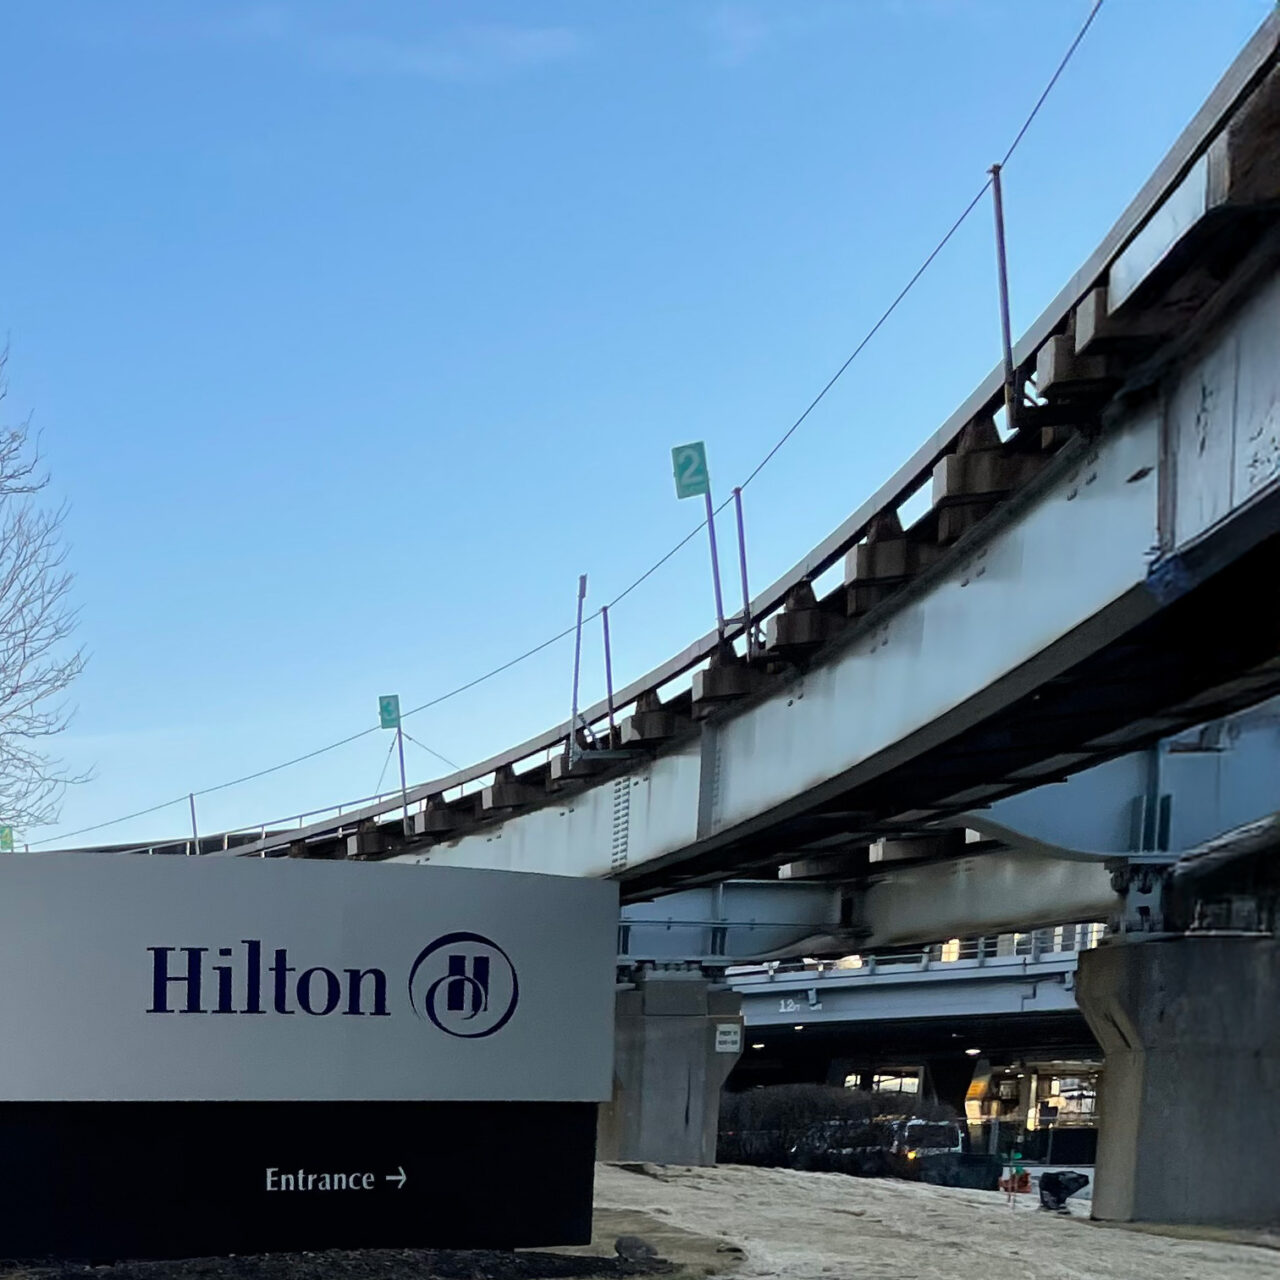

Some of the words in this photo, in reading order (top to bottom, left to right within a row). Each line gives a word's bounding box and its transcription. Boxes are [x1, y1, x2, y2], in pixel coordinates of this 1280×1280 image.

[679, 448, 706, 487] 2
[145, 939, 391, 1016] Hilton
[266, 1167, 375, 1191] Entrance
